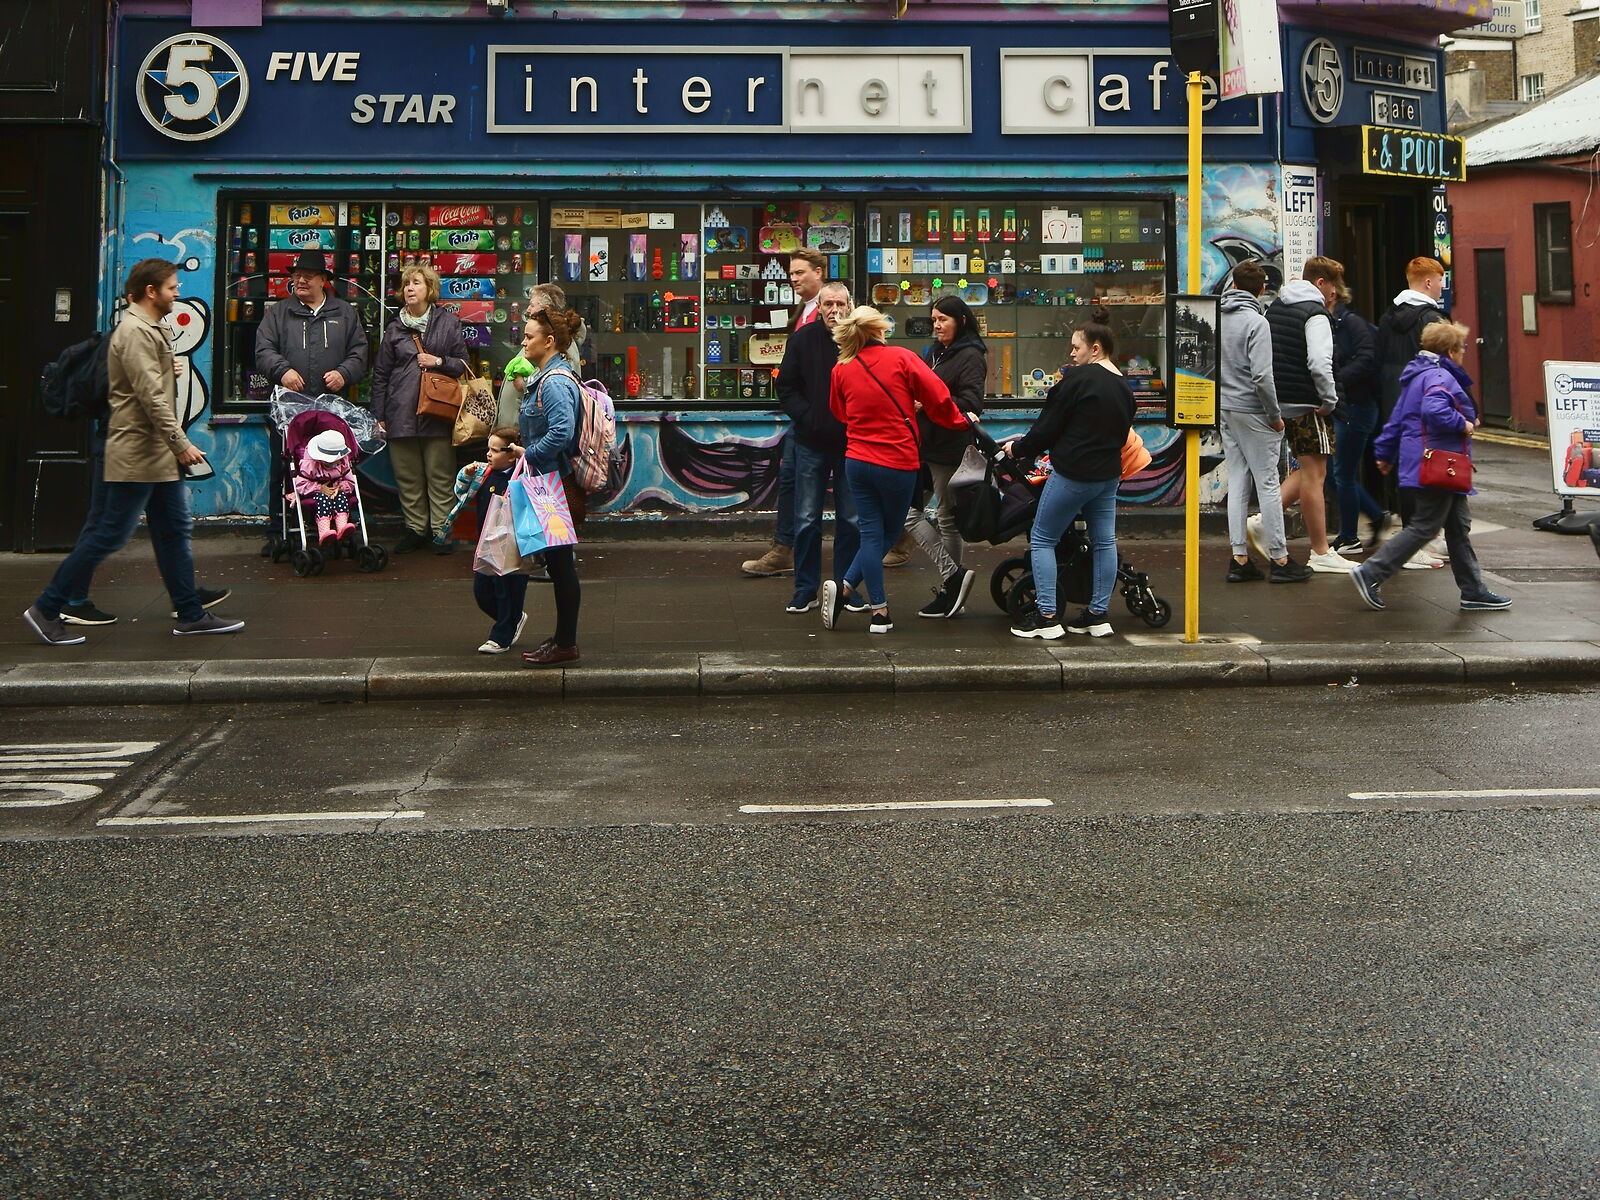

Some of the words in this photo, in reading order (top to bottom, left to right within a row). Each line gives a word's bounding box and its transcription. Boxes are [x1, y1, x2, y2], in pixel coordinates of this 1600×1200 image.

[1480, 22, 1517, 33] Hours
[266, 52, 360, 81] FIVE
[163, 44, 219, 120] 5
[1314, 47, 1339, 112] 5
[351, 94, 456, 123] STAR
[1380, 133, 1392, 169] &
[1401, 137, 1450, 176] POOL
[1285, 191, 1315, 213] LEFT
[1433, 195, 1447, 212] OL
[288, 205, 320, 222] Fanta
[1285, 215, 1316, 227] LUGGAGE
[1435, 220, 1446, 235] €6
[288, 229, 320, 246] Fanta
[448, 230, 479, 246] Fanta
[449, 279, 481, 297] Fanta
[1555, 398, 1587, 411] LEFT
[1556, 413, 1589, 421] LUGGAGE
